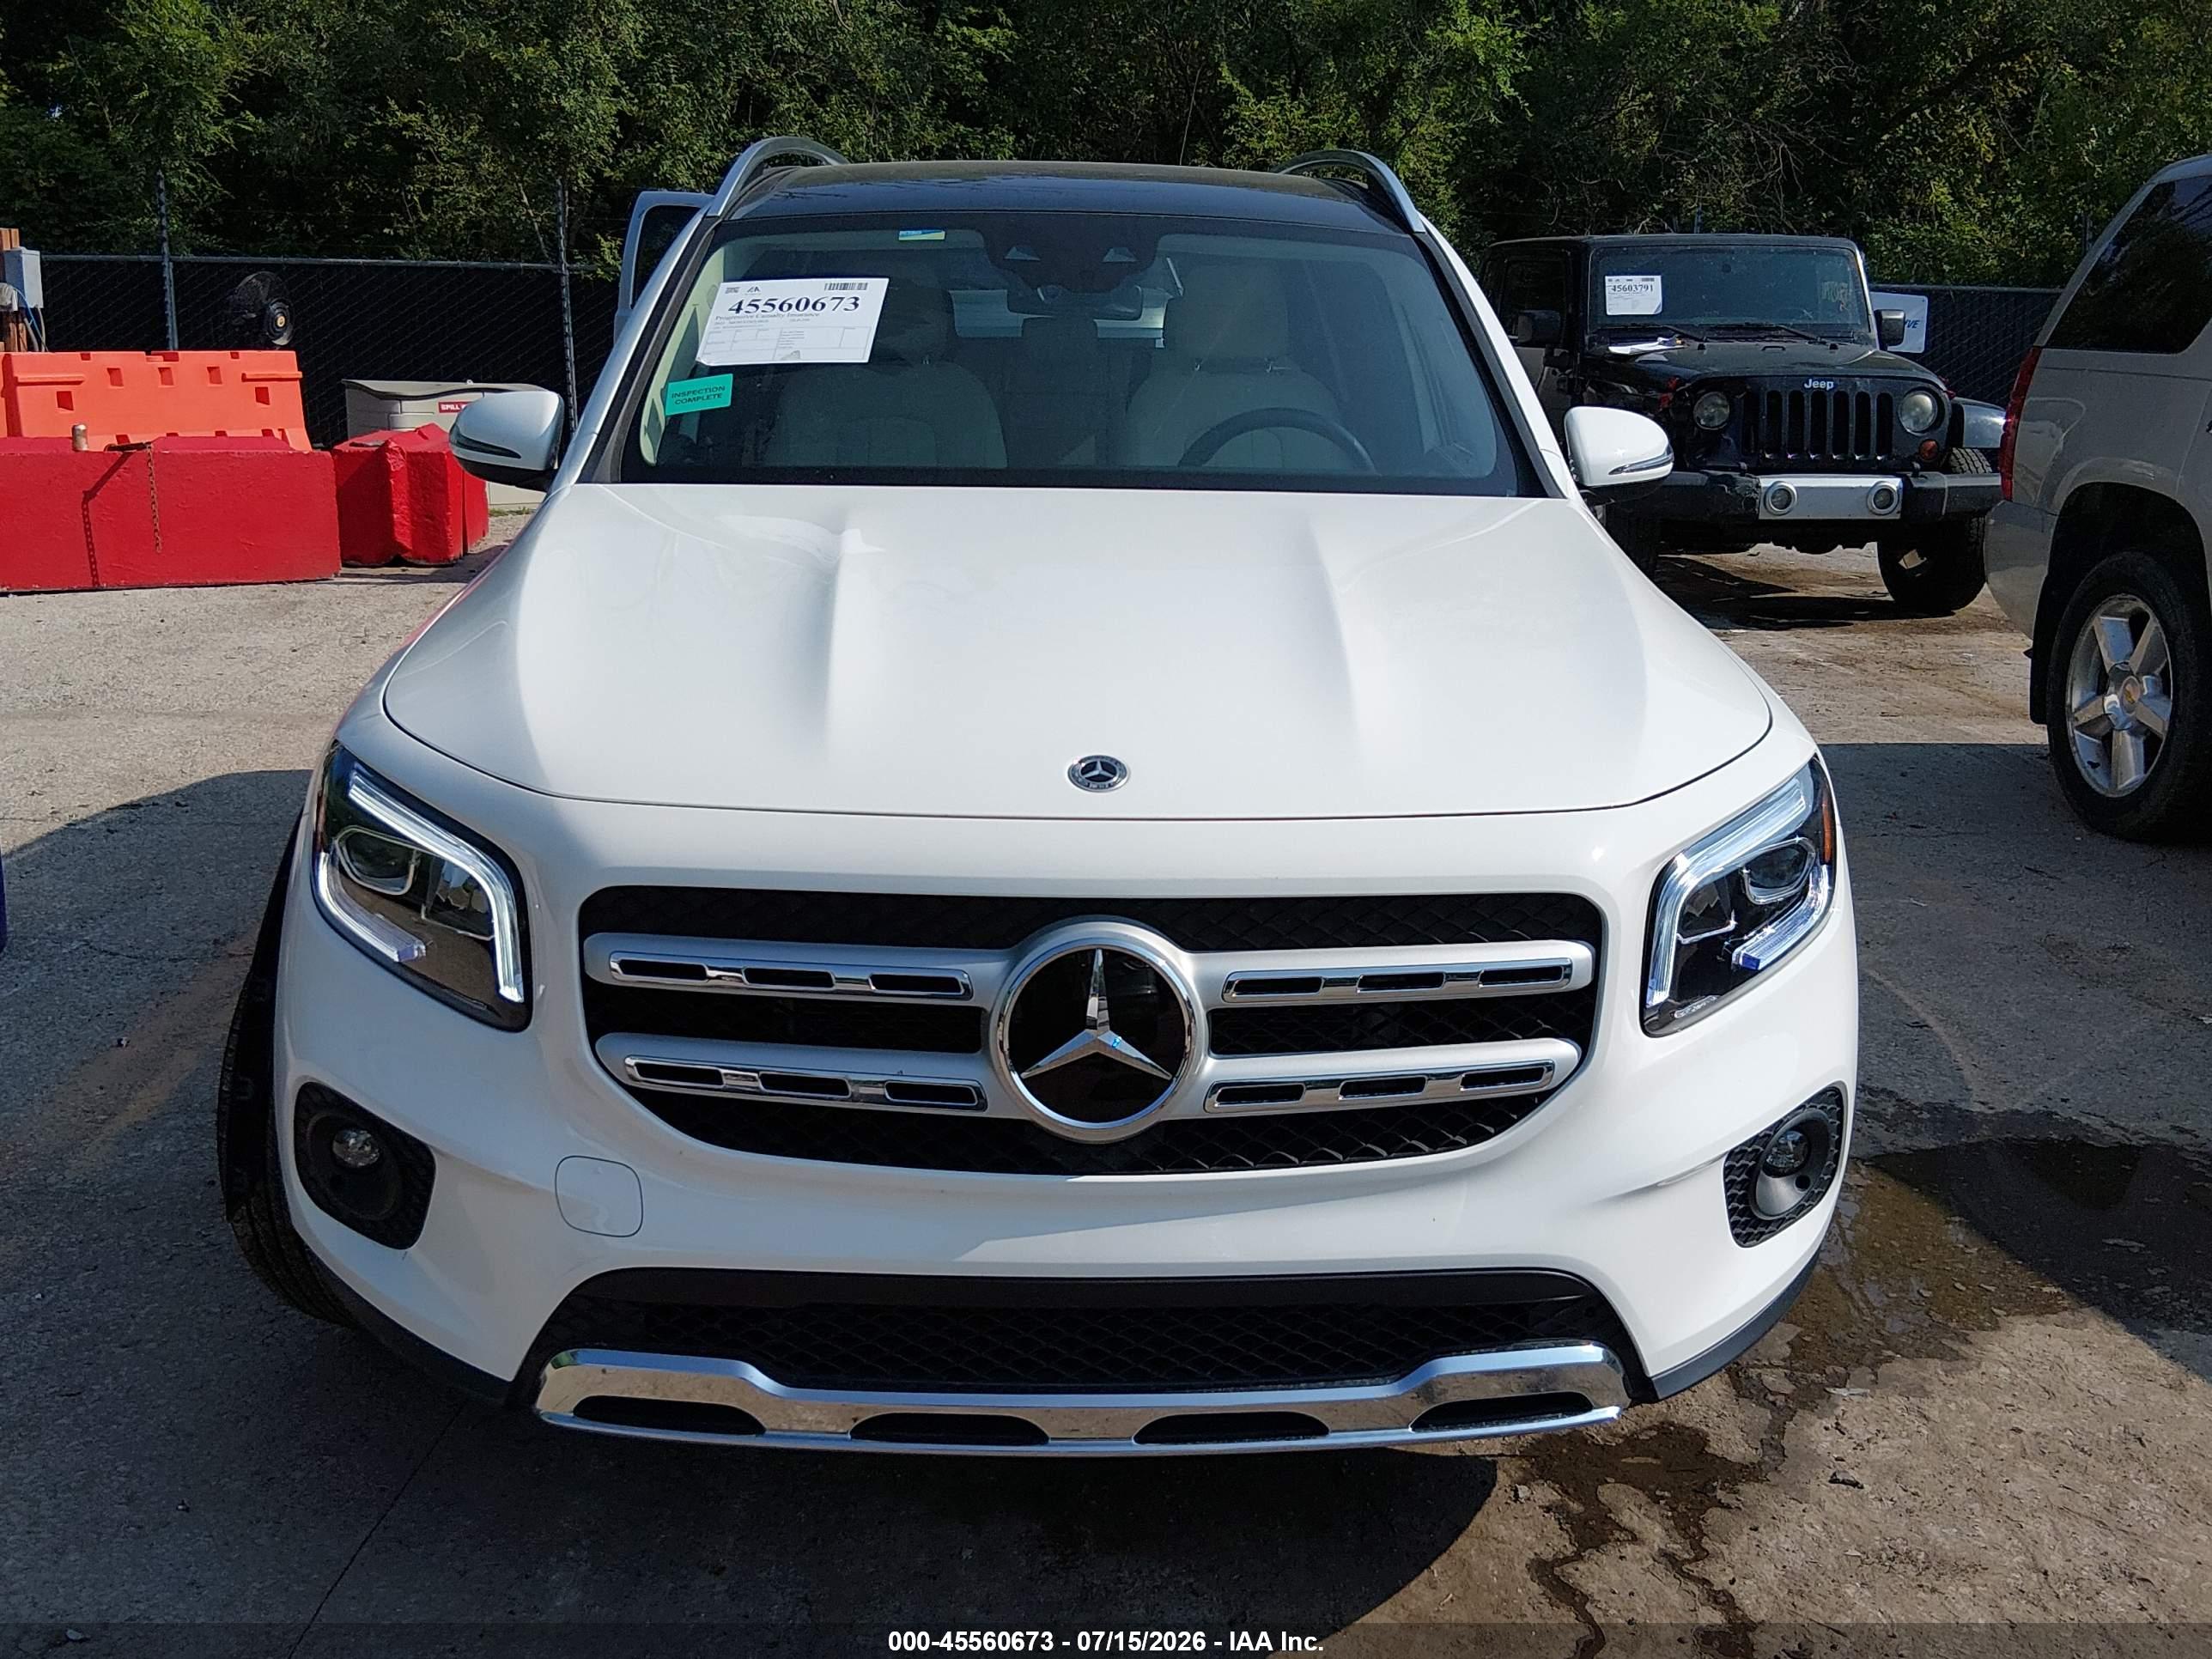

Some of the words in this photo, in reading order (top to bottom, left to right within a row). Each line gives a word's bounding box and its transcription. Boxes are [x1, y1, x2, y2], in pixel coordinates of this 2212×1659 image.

[728, 295, 860, 314] 45560673
[1803, 378, 1834, 391] Jeep
[672, 385, 726, 399] INSPECTION
[674, 392, 722, 404] COMPLETE
